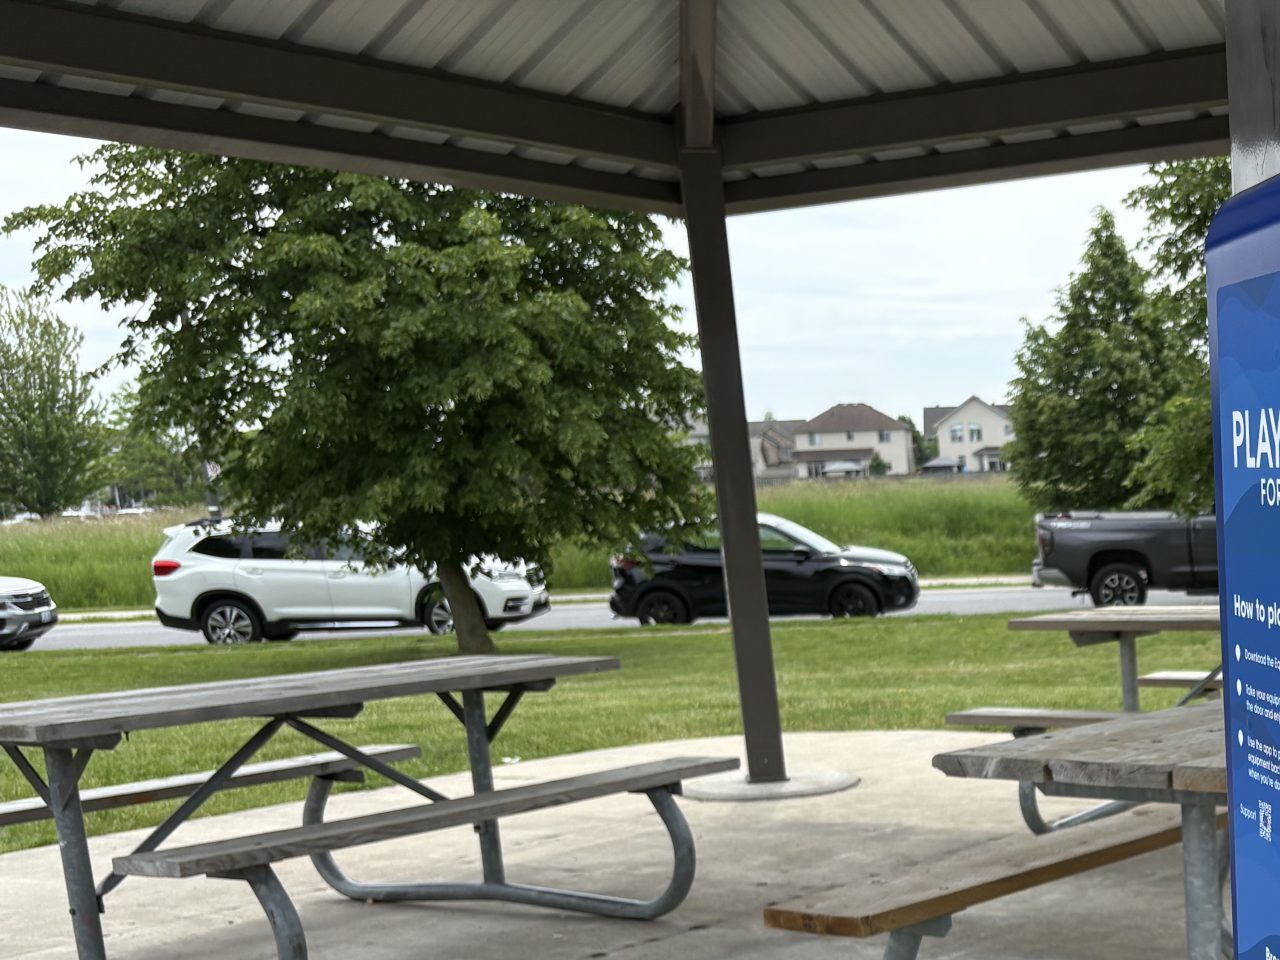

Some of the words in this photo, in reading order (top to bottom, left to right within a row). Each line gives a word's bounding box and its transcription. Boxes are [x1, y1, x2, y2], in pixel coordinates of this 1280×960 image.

[1233, 594, 1253, 620] How
[1255, 598, 1265, 622] to
[1244, 648, 1266, 666] Download
[1266, 655, 1274, 668] the
[1245, 683, 1256, 697] Take
[1256, 689, 1266, 701] your
[1253, 703, 1264, 716] door
[1264, 708, 1273, 720] and
[1247, 735, 1255, 748] Use
[1262, 744, 1272, 757] app
[1272, 746, 1277, 758] to
[1247, 753, 1271, 771] equipment
[1247, 768, 1260, 781] when
[1240, 803, 1257, 821] Support
